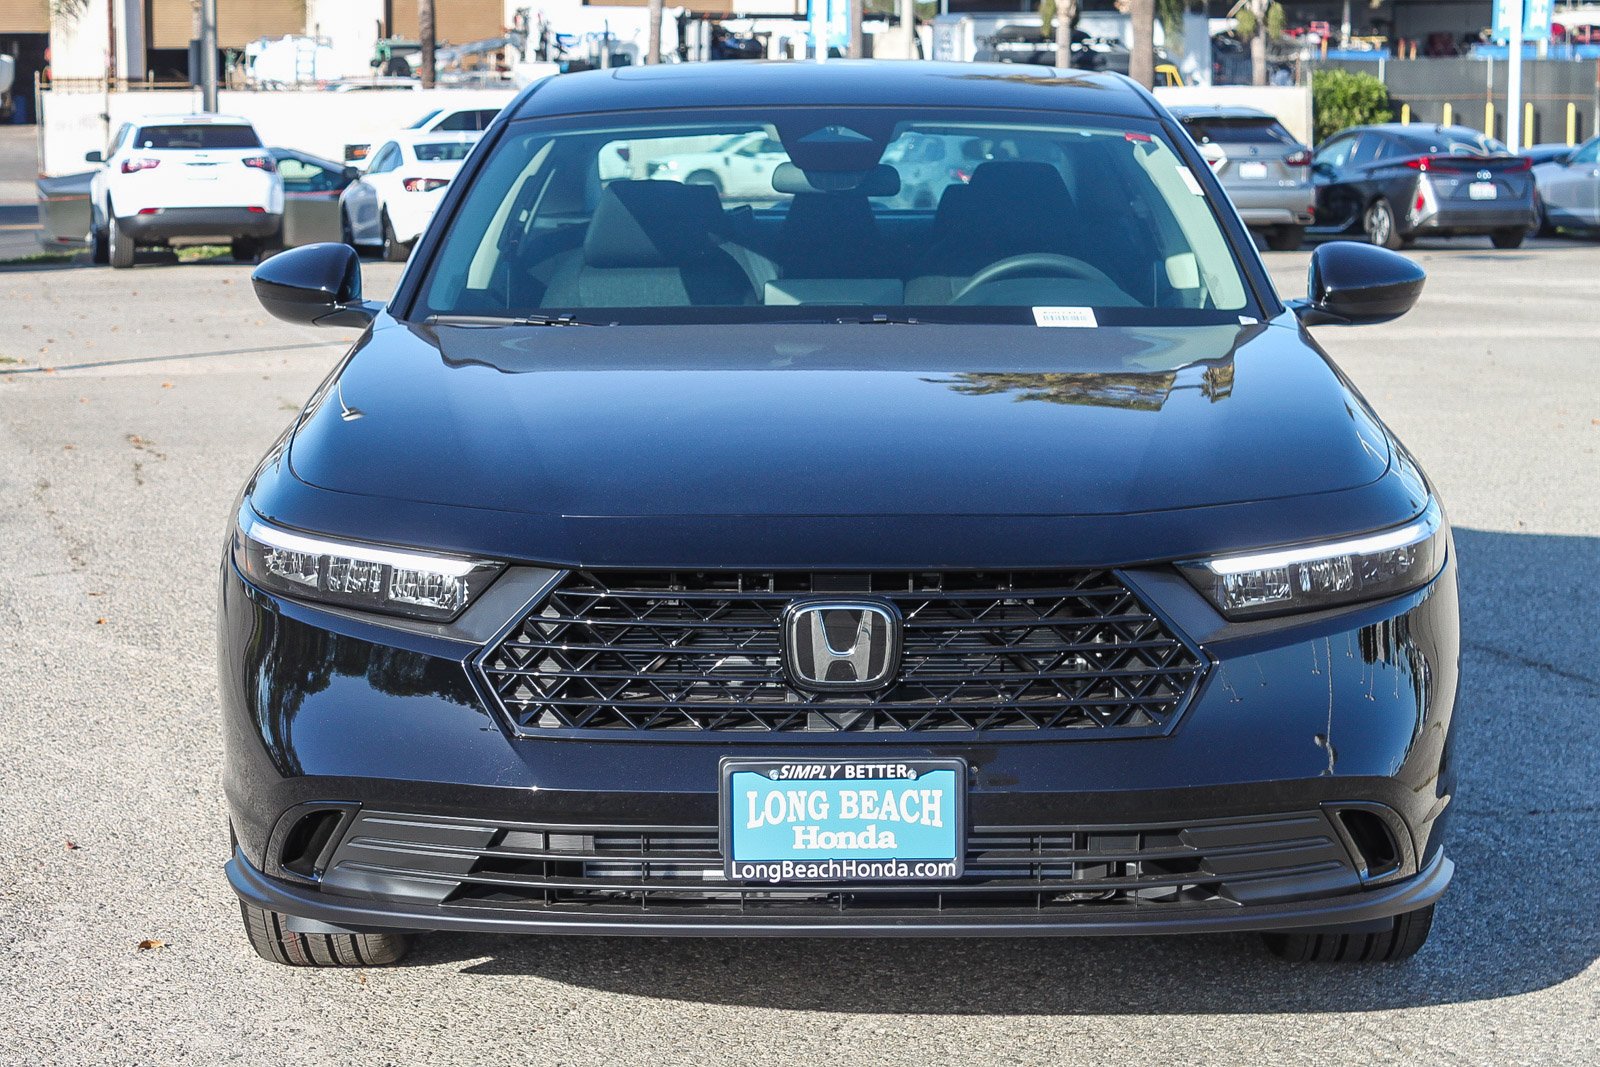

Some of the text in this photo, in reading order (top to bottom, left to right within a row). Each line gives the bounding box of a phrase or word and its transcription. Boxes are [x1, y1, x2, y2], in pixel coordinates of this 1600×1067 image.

[779, 764, 907, 780] SIMPLY BETTER
[746, 789, 943, 829] LONG BEACH
[792, 824, 897, 850] Honda
[731, 858, 956, 883] LongBeachHonda.com
